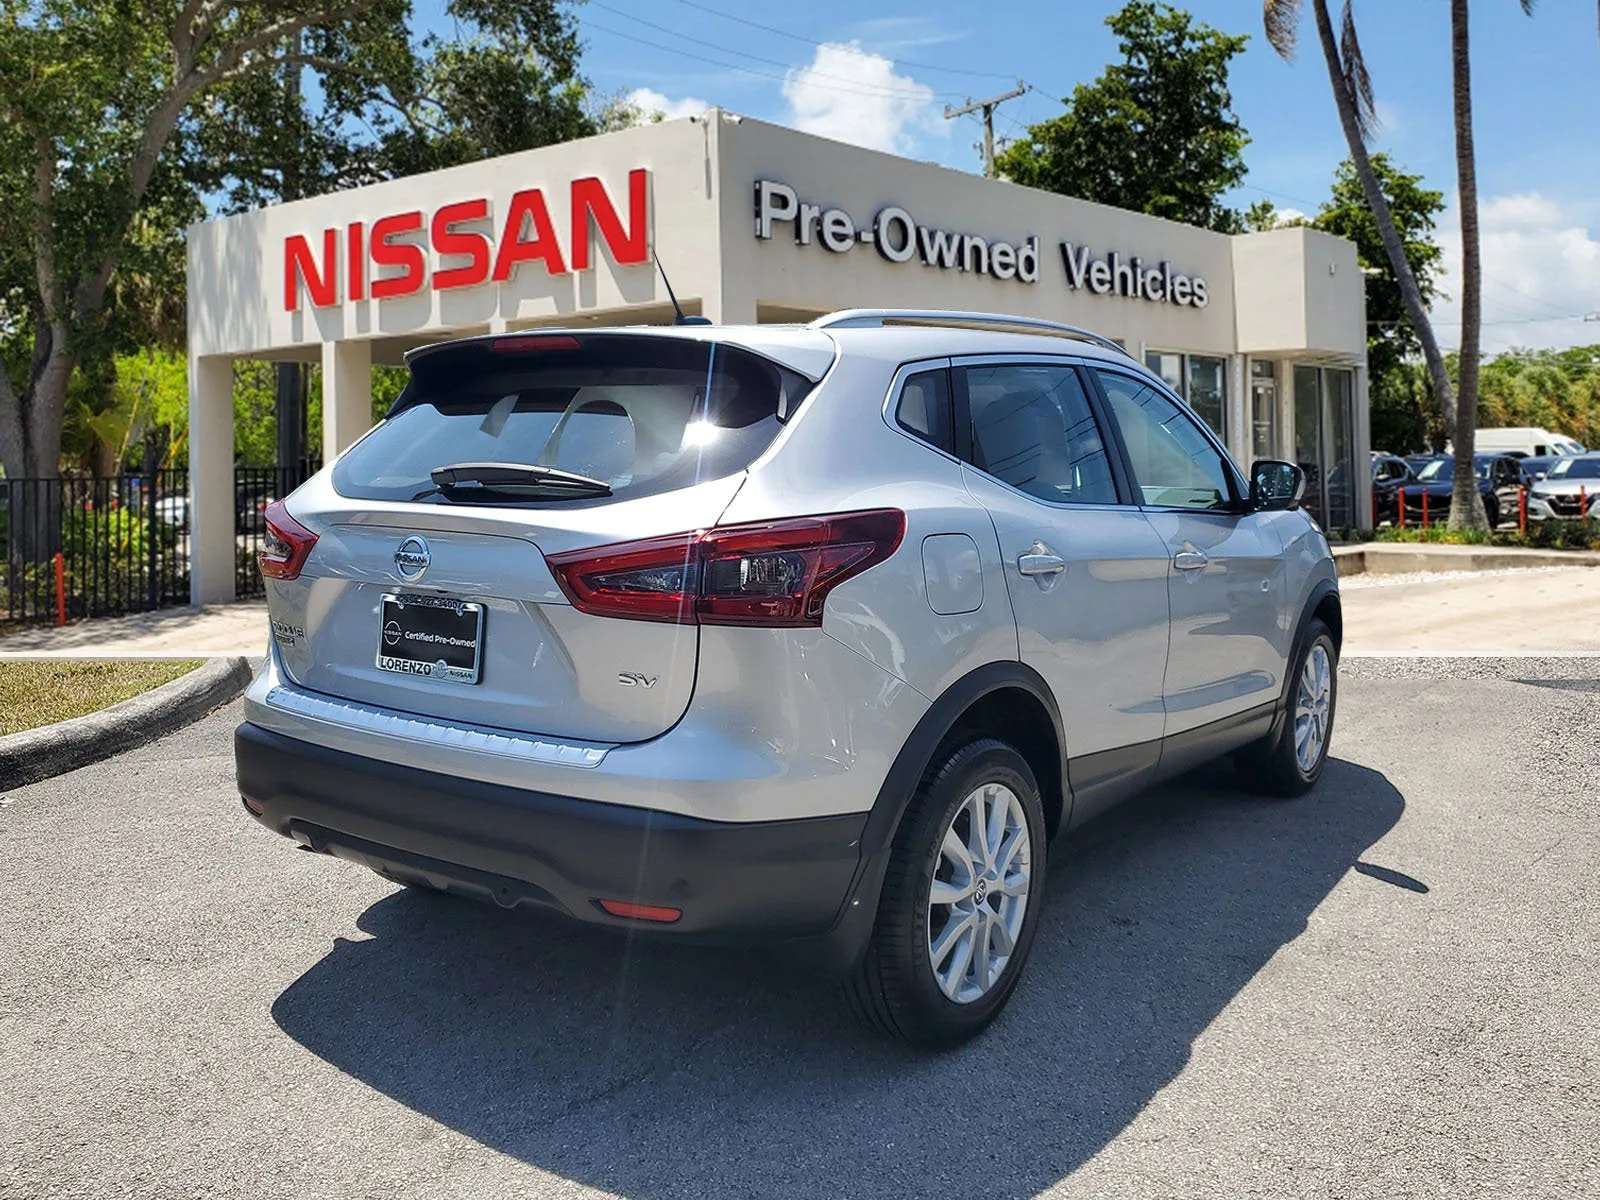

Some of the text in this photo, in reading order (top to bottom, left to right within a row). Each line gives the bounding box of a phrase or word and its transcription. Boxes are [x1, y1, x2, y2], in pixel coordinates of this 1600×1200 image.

[284, 168, 648, 312] NISSAN
[754, 180, 1209, 309] Pre-Owned Vehicles
[404, 631, 476, 648] Certified Pre-Owned
[381, 657, 473, 680] LORENZO NISSAN
[618, 671, 662, 689] SV
